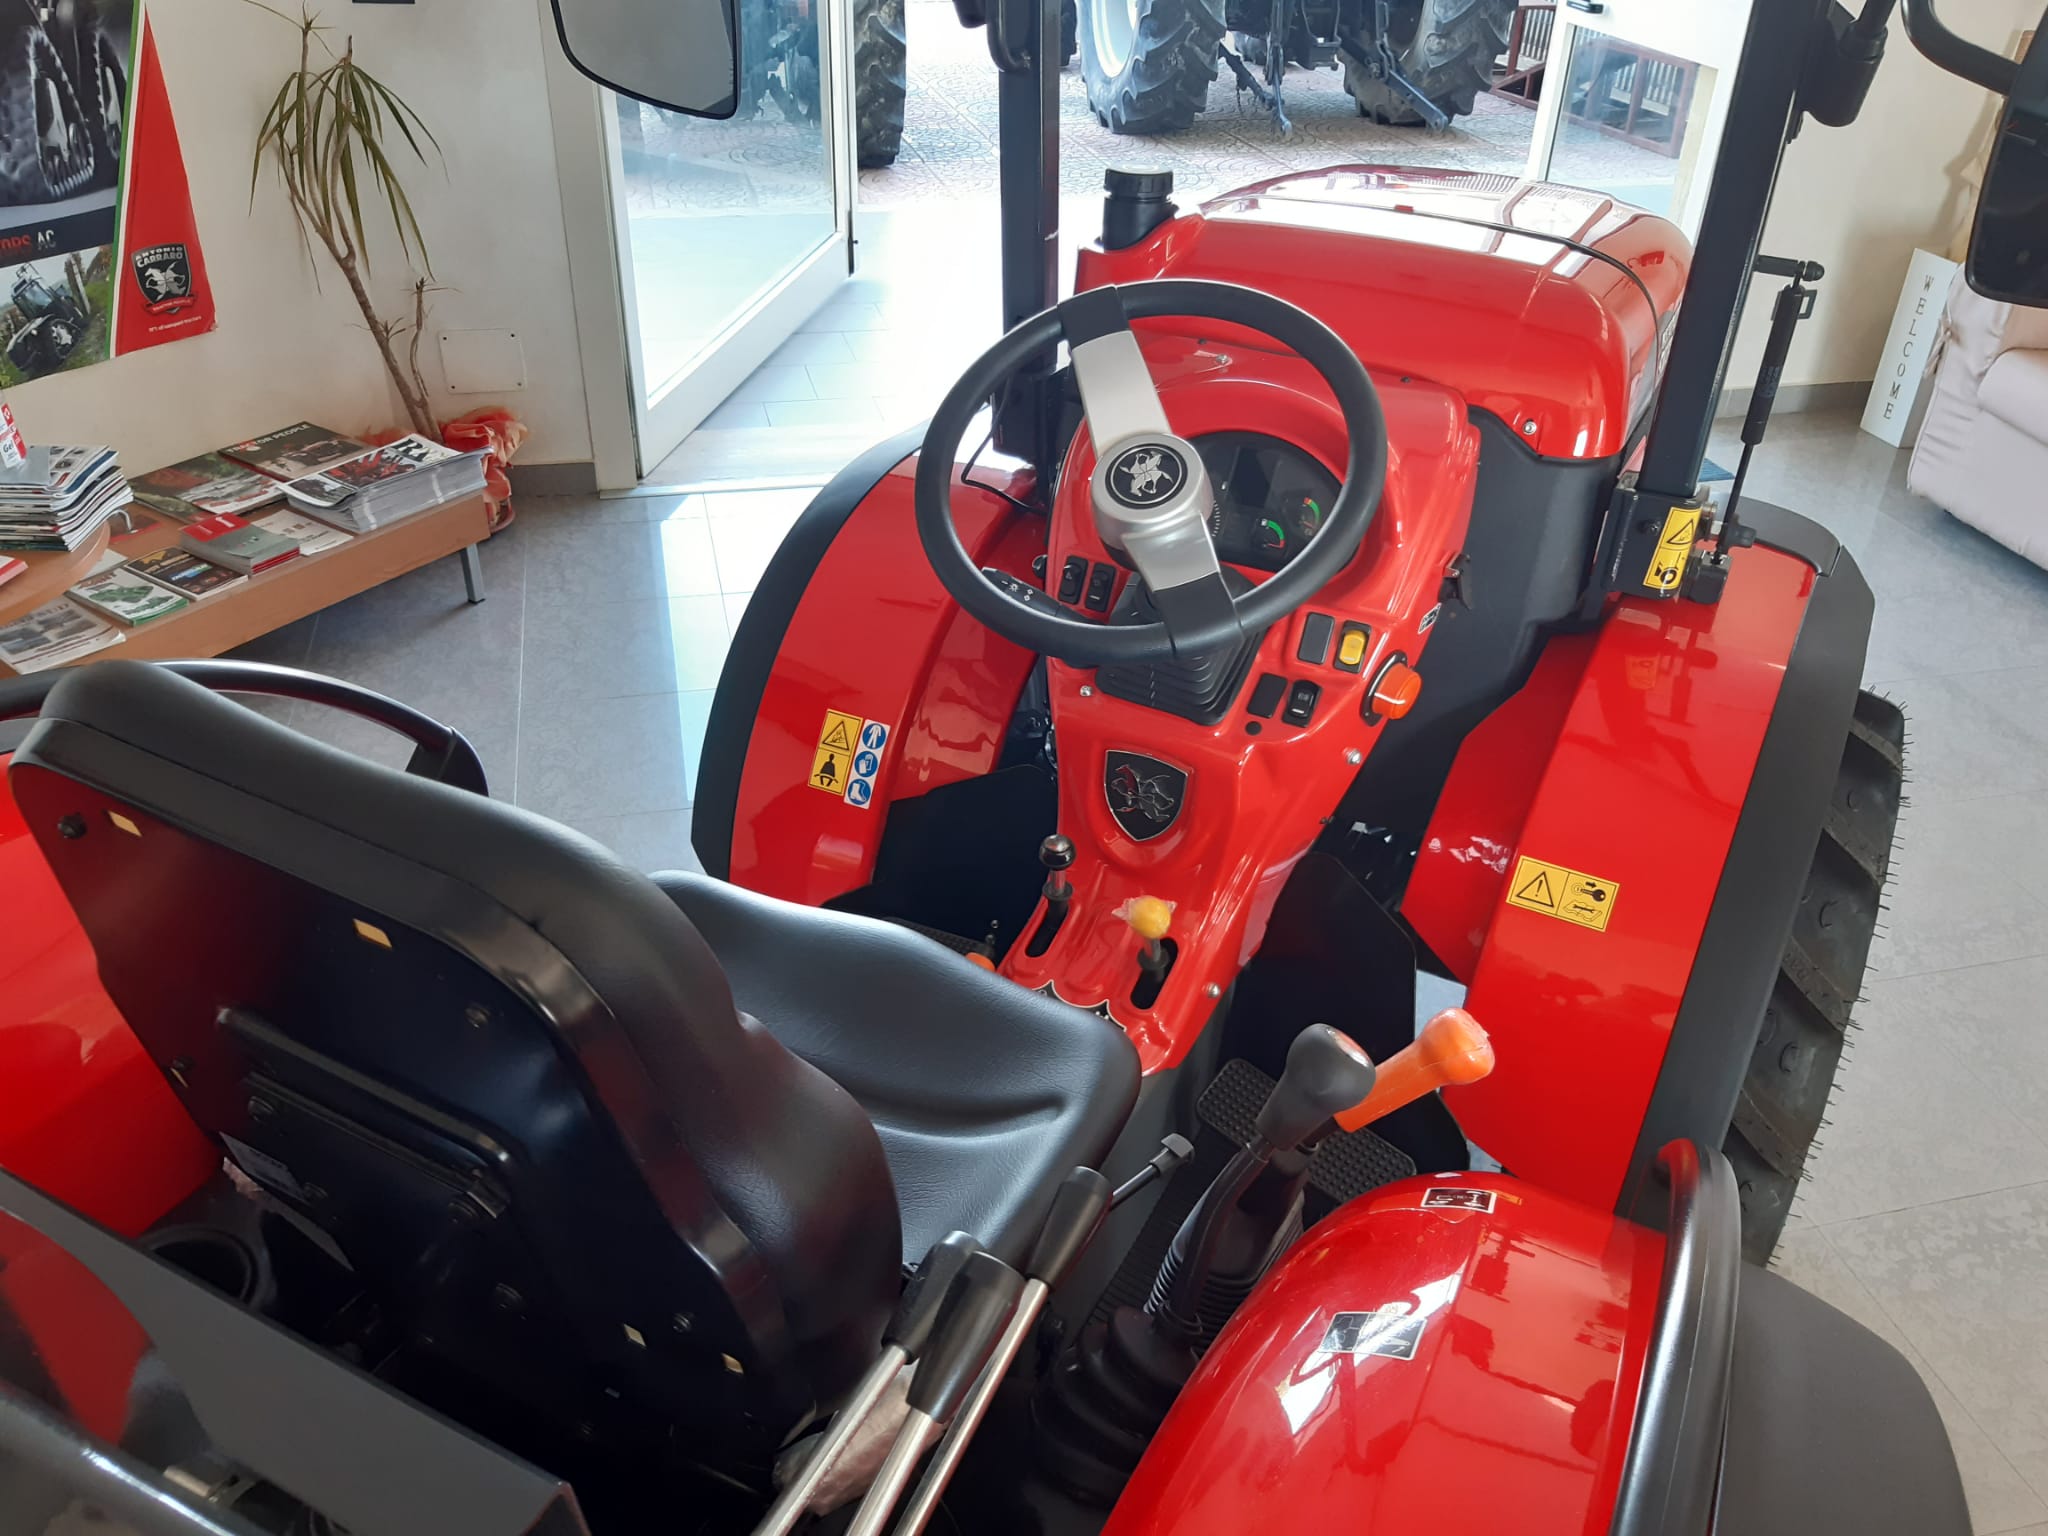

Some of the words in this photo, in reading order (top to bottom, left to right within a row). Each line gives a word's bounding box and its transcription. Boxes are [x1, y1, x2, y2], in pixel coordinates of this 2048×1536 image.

[37, 229, 56, 250] AC
[135, 246, 183, 260] ANTONIO
[137, 251, 183, 267] CARRARO
[1882, 274, 1935, 420] WELCOME
[225, 437, 274, 453] TRAOR
